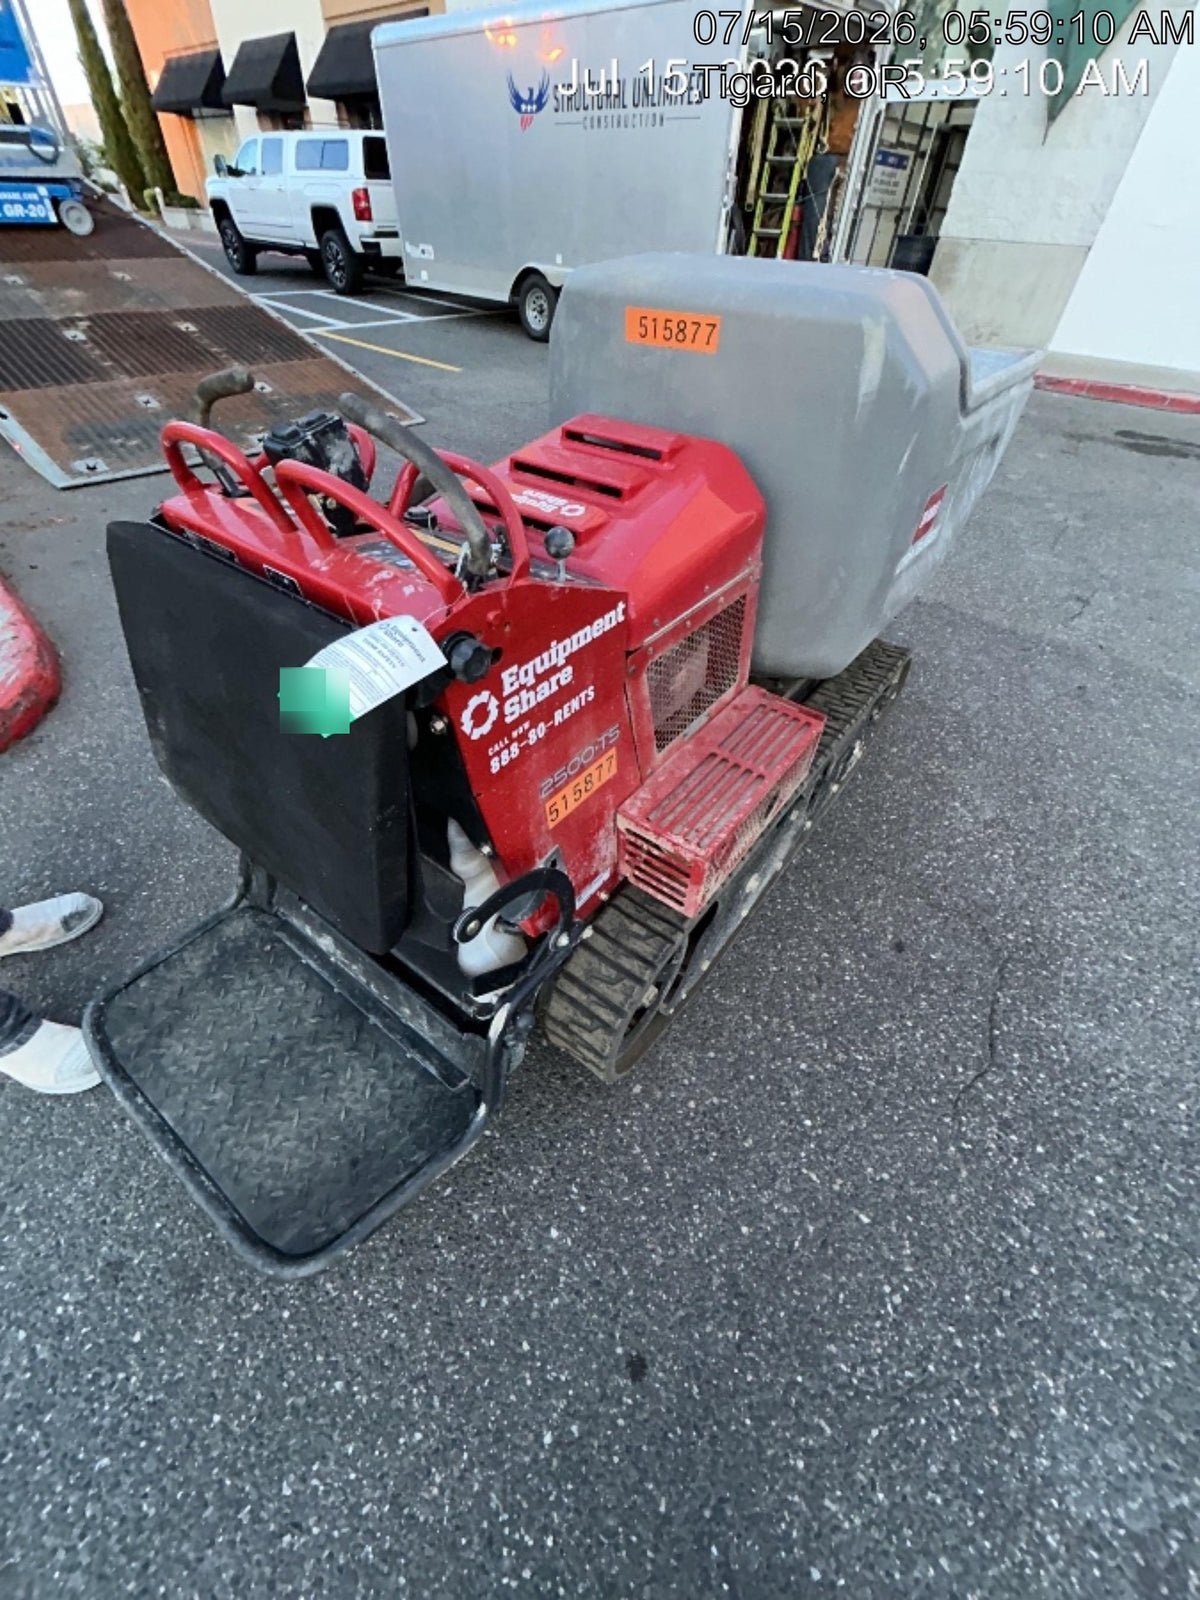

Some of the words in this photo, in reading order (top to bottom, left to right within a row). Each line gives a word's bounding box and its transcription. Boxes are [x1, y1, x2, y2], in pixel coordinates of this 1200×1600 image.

[582, 111, 664, 130] CONSTRUCTION
[3, 203, 46, 218] GR-20
[639, 315, 718, 346] 515877
[501, 600, 627, 698] Equipment
[503, 664, 574, 724] Share
[489, 685, 596, 774] 888-80-RENTS
[548, 754, 616, 823] 515877
